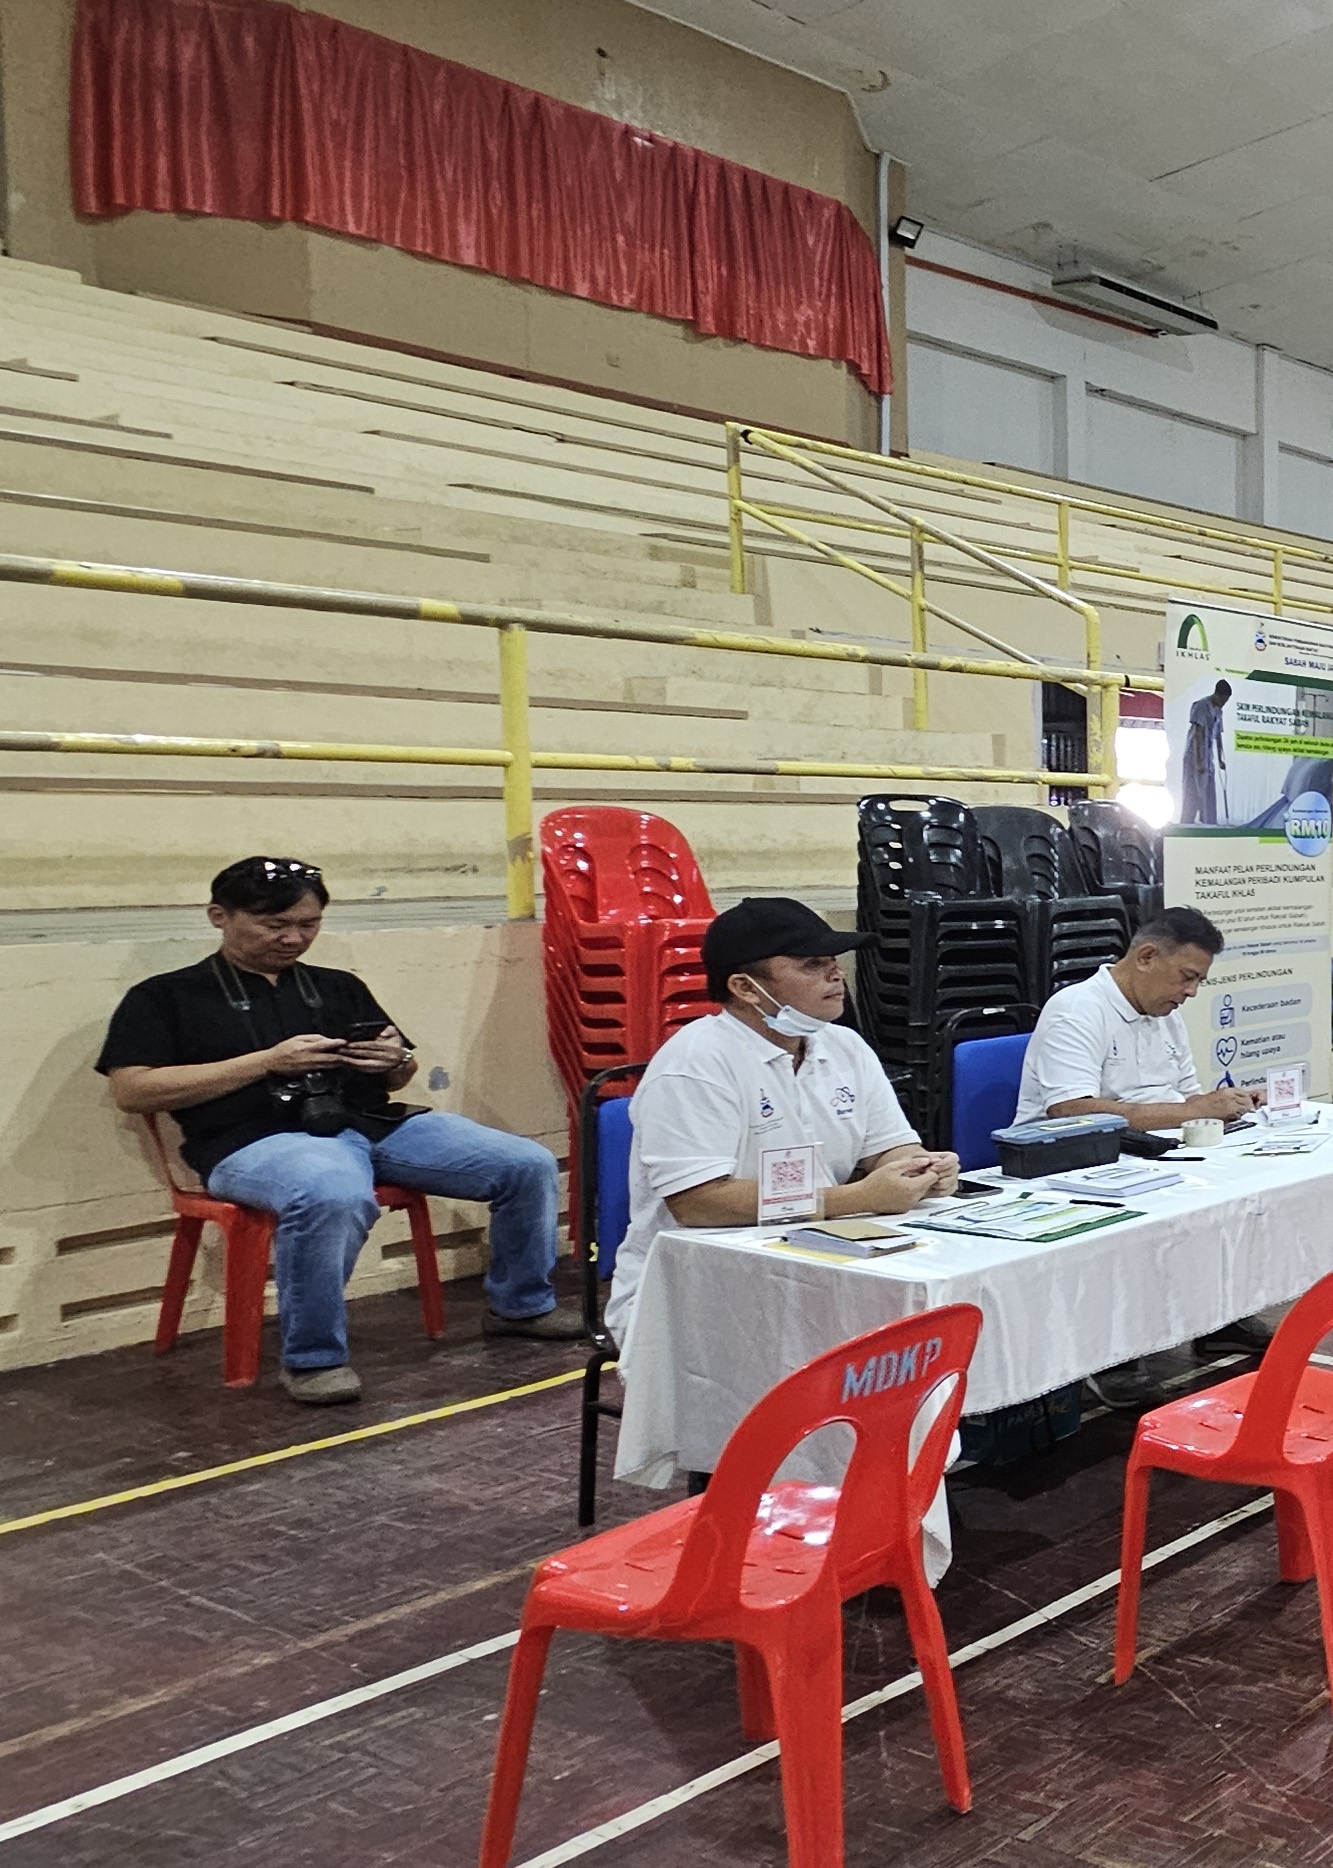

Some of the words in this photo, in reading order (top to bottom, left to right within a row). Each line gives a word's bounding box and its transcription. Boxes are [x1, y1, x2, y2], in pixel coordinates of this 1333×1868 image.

[1176, 651, 1211, 661] IKHLAS
[1284, 656, 1307, 668] SABAH
[1290, 819, 1329, 838] RM10
[1195, 866, 1231, 875] MANFAAT
[1233, 865, 1254, 874] PELAN
[1256, 864, 1316, 873] PERLINDUNGAN
[1195, 877, 1246, 888] KEMALANGAN
[1248, 875, 1281, 885] PERIBADI
[1283, 875, 1325, 884] KUMPULAN
[1195, 891, 1230, 900] TAKAFUL
[1232, 888, 1256, 898] IKHLAS
[1199, 975, 1237, 987] ENIS-JENIS
[1238, 968, 1294, 981] PERLINDUNGAN
[1241, 1001, 1279, 1013] Kecederaan
[1280, 998, 1302, 1007] badan
[1241, 1036, 1270, 1046] Kematian
[1240, 1050, 1260, 1060] hilang
[1262, 1046, 1281, 1055] upaya
[840, 1336, 943, 1404] MDKP
